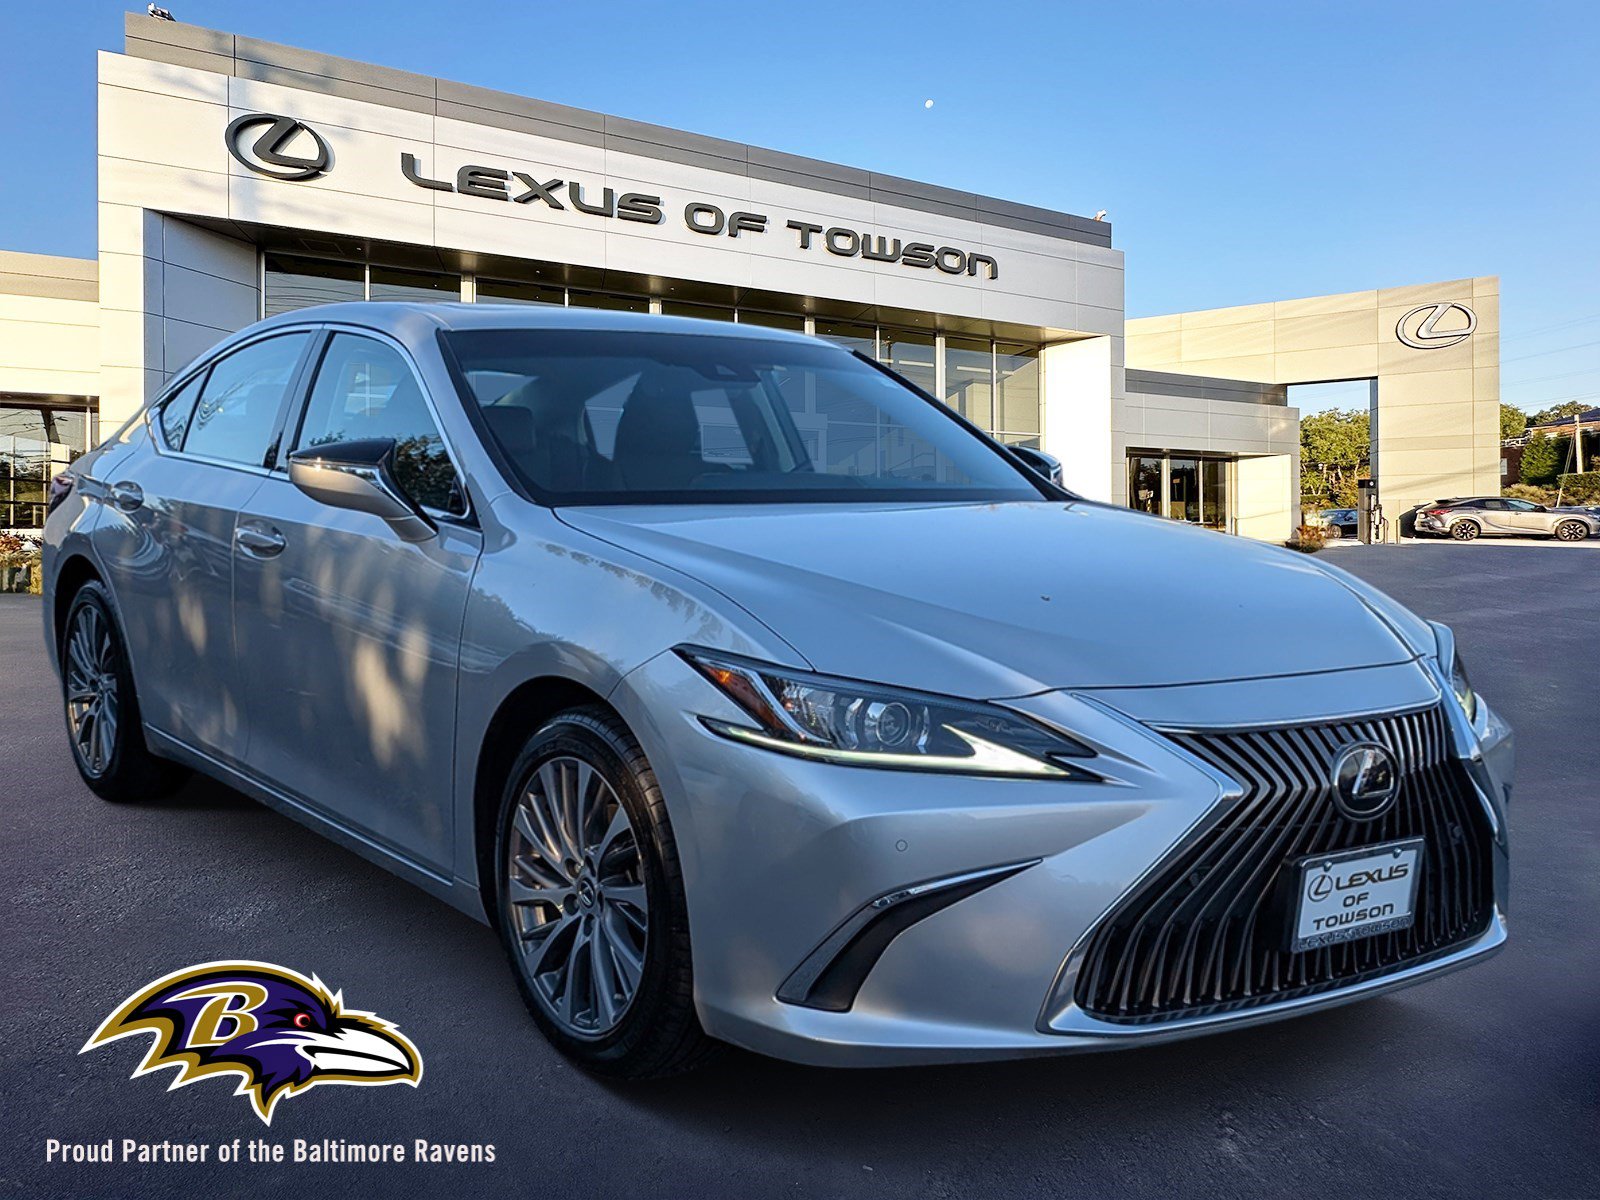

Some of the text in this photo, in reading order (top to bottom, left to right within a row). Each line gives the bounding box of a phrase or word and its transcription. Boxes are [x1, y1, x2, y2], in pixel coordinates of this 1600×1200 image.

[401, 152, 999, 280] LEXUS OF TOWSON
[1335, 864, 1409, 891] LEXUS
[1343, 892, 1369, 908] OF
[1313, 903, 1394, 931] TOWSON
